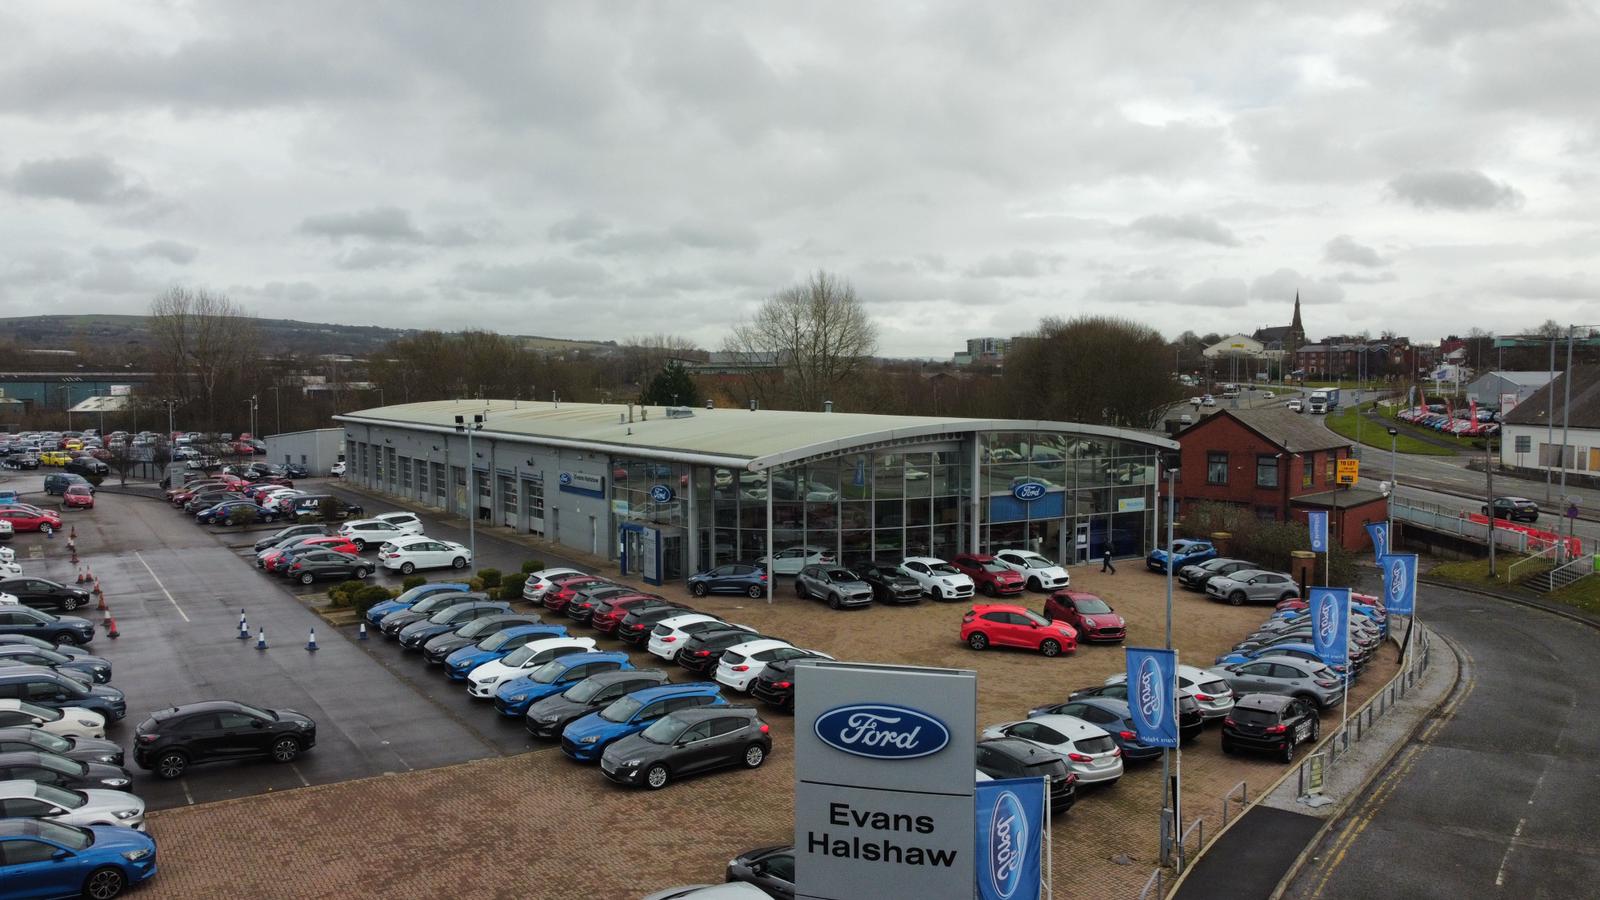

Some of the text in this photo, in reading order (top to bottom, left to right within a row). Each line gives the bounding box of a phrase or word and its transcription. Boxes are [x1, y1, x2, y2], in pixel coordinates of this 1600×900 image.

[1021, 486, 1041, 497] Ford
[840, 713, 922, 749] Ford
[830, 802, 935, 834] Evans
[808, 831, 957, 867] Halshaw
